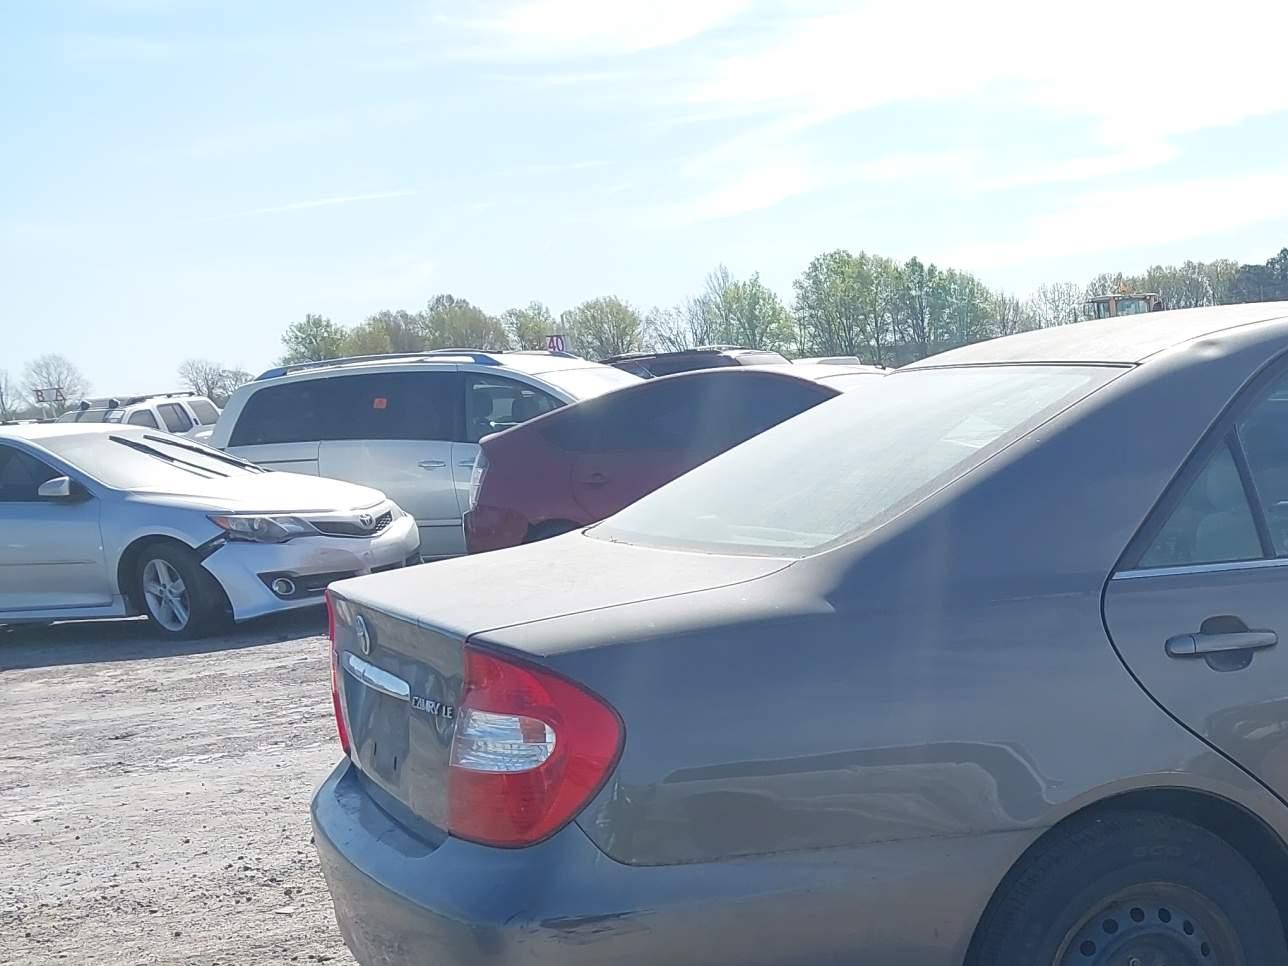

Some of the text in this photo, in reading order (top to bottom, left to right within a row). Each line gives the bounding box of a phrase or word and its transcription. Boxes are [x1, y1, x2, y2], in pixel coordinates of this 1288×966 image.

[549, 335, 565, 351] 40
[35, 388, 67, 402] B A
[411, 696, 453, 719] CAMRY LE
